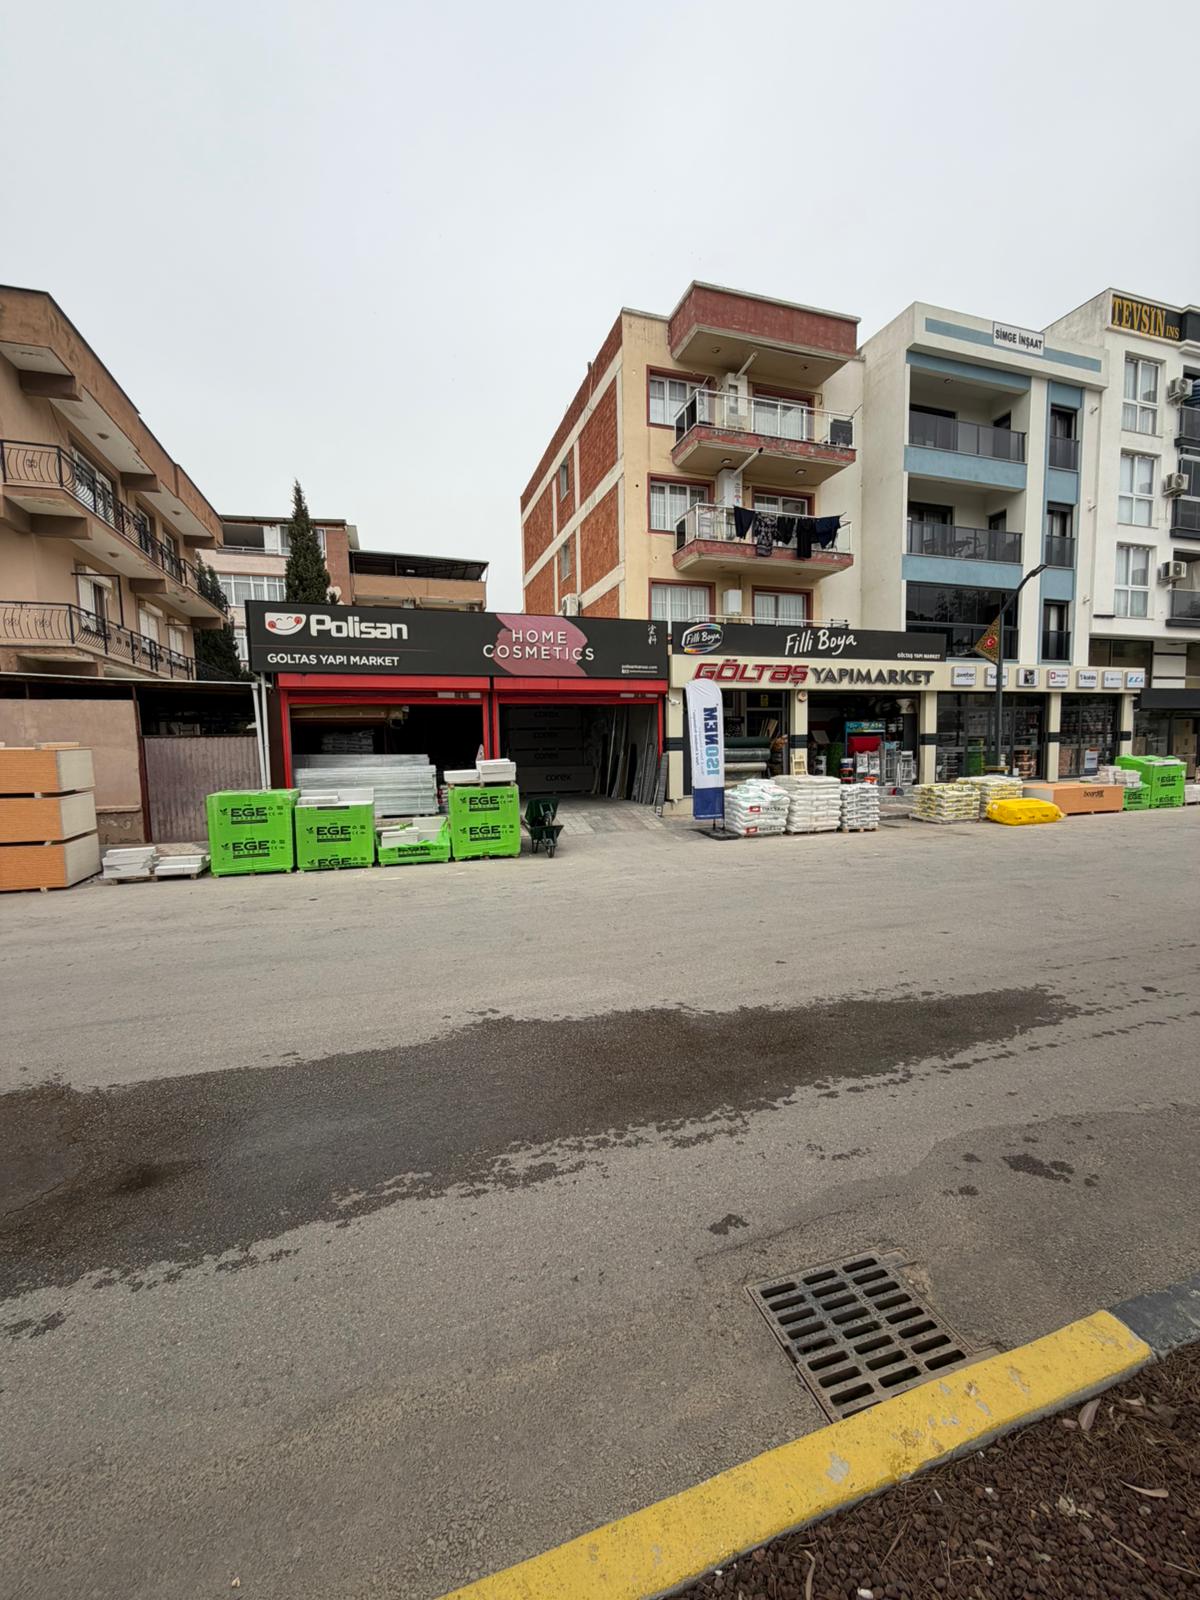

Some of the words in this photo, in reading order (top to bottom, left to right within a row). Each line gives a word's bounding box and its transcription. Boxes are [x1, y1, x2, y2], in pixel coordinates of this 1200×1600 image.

[996, 328, 1016, 343] SİMGE
[1018, 333, 1042, 350] İNŞAAT
[310, 614, 408, 640] Polisan
[512, 630, 568, 644] HOME
[686, 632, 700, 644] Filli
[701, 632, 720, 644] Boya
[784, 630, 814, 656] Filli
[817, 629, 857, 656] Boya
[483, 645, 594, 660] COSMETICS
[267, 653, 317, 664] GOLTAS
[320, 654, 347, 665] YAPI
[350, 656, 400, 666] MARKET
[469, 796, 499, 806] EGE
[231, 807, 267, 818] EGE
[317, 826, 351, 836] EGE
[470, 826, 500, 835] EGE
[232, 840, 270, 852] EGE
[318, 858, 352, 866] EGE
